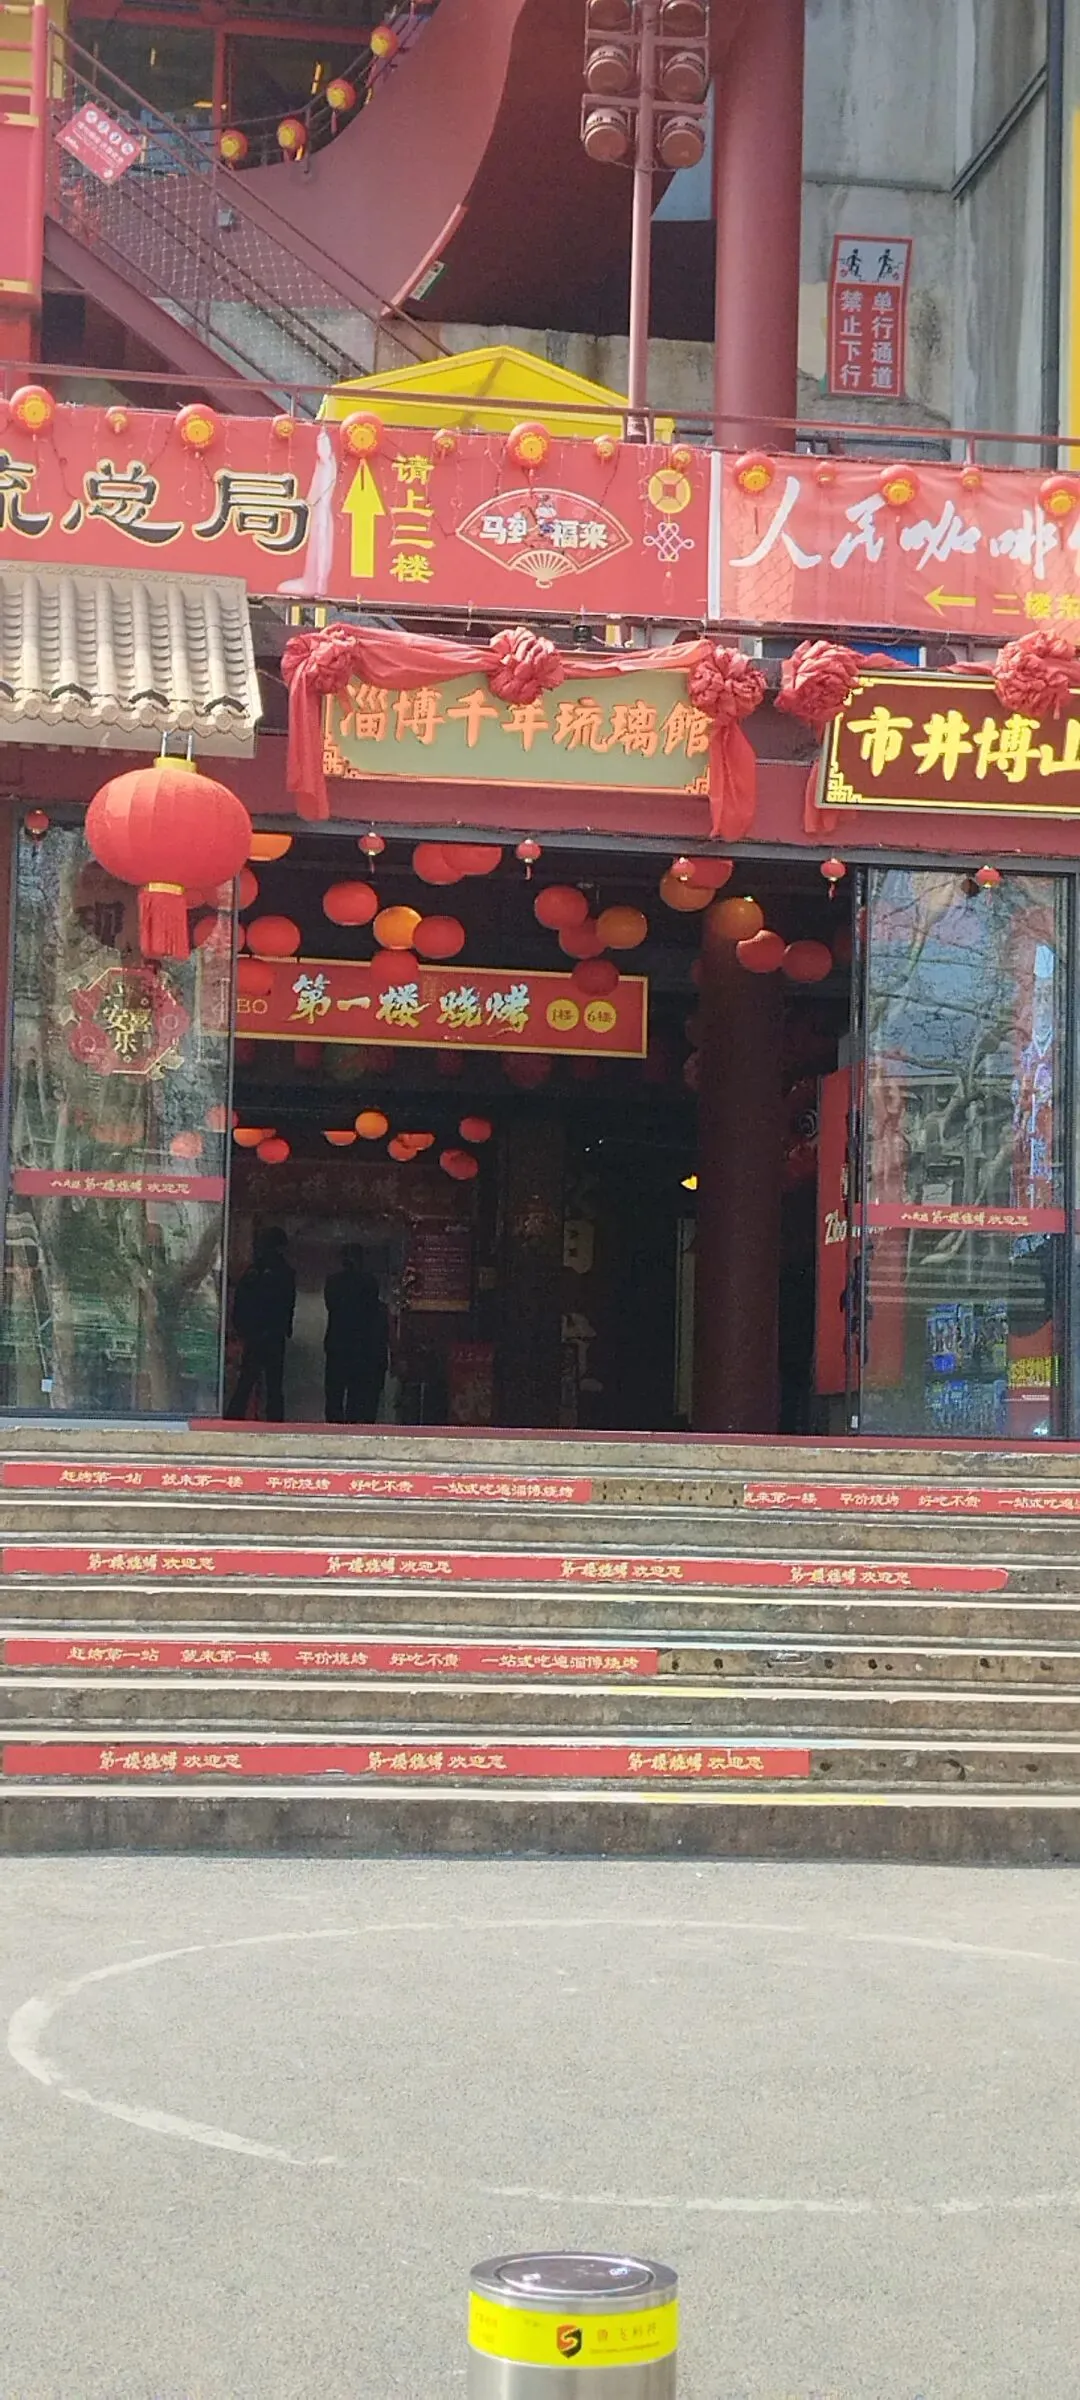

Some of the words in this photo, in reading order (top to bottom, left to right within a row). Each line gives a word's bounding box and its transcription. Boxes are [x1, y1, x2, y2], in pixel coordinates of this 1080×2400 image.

[840, 289, 864, 388] 禁止下行
[871, 291, 894, 389] 单行通道
[389, 454, 435, 584] 请上二楼
[998, 1496, 1080, 1511] 一站式吃遍
[162, 1556, 216, 1571] 欢迎您
[400, 1559, 452, 1574] 欢迎您
[632, 1564, 684, 1579] 欢迎您
[860, 1570, 912, 1585] 欢迎您
[296, 1650, 369, 1666] 平价烧烤
[388, 1652, 460, 1668] 好吃不贵
[182, 1753, 243, 1769] 欢迎您
[447, 1754, 508, 1770] 欢迎您
[707, 1754, 765, 1771] 欢迎您
